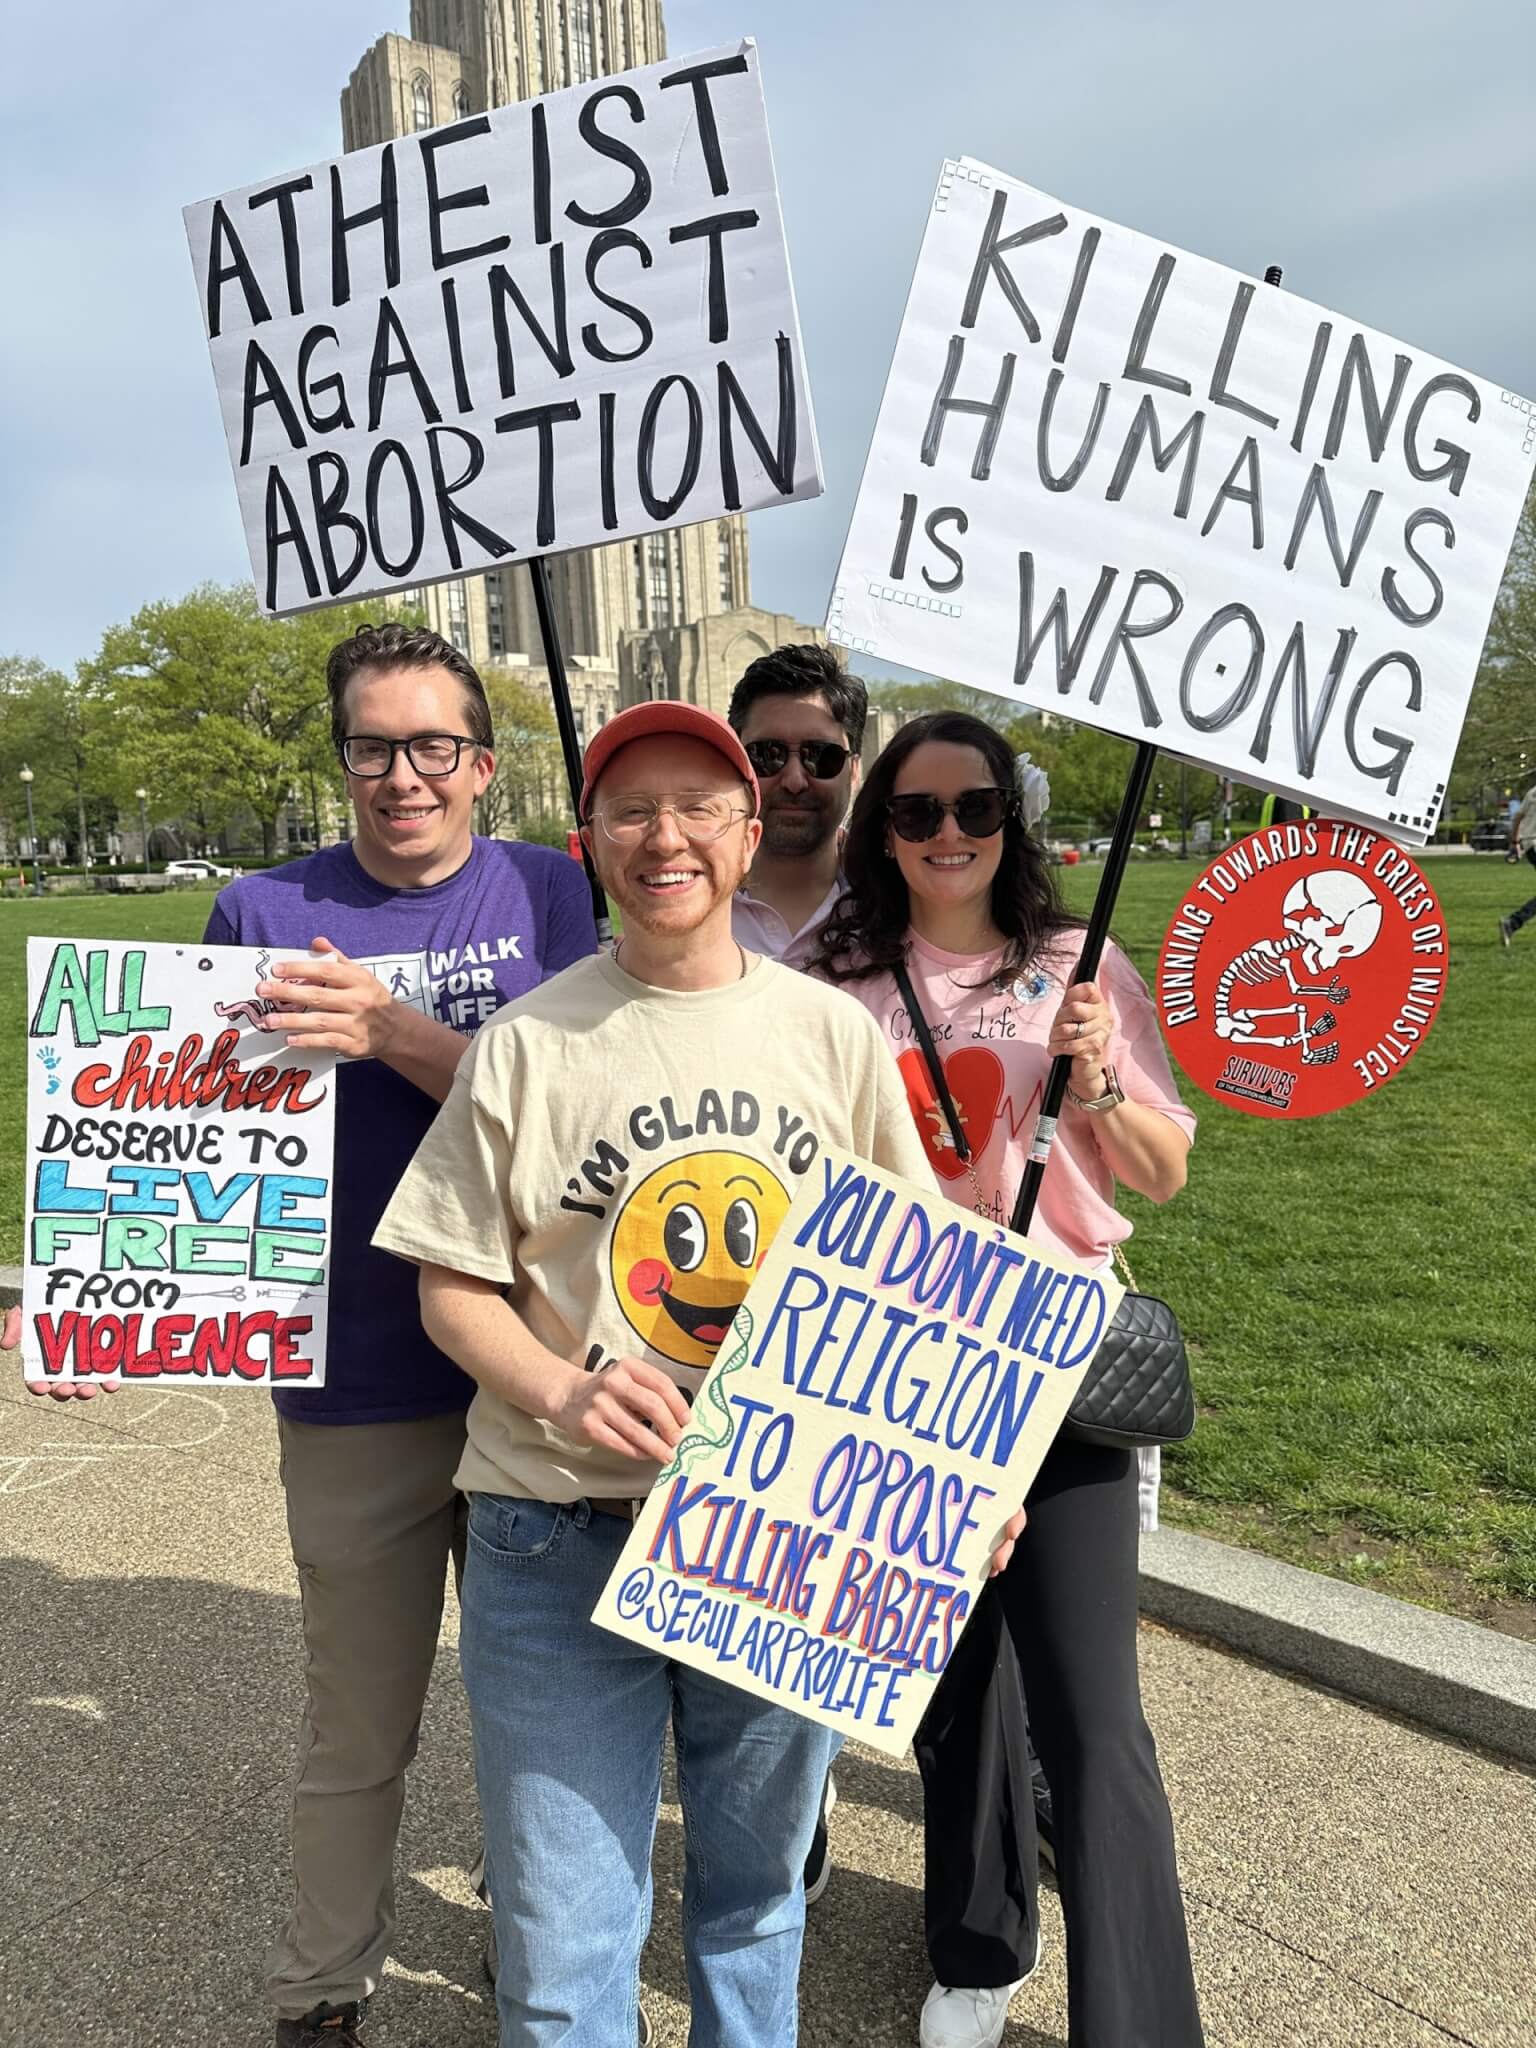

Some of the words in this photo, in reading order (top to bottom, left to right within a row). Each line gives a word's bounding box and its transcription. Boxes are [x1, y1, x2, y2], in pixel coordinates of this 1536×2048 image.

[207, 54, 749, 338] ATHEIST
[240, 209, 760, 466] AGAINST
[960, 190, 1481, 496] KILLING
[266, 331, 797, 611] ABORTION
[920, 334, 1456, 628] HUMANS
[890, 493, 968, 593] IS
[1013, 551, 1422, 796] WRONG
[1197, 822, 1319, 903] TOWARDS
[1329, 823, 1377, 867] THE
[1374, 848, 1434, 920] CRIES
[430, 936, 523, 975] WALK
[430, 968, 496, 1004] FOR
[1162, 903, 1214, 1027] RUNNING
[1411, 923, 1445, 955] OF
[30, 943, 172, 1048] ALL
[435, 996, 497, 1028] LIFE
[971, 1006, 1017, 1039] Life
[1353, 967, 1443, 1088] INJUSTICE
[72, 1029, 328, 1114] children
[1223, 1055, 1297, 1096] SURVIVORS
[36, 1114, 224, 1163] DESERVE
[238, 1128, 309, 1167] TO
[560, 1138, 630, 1220] I'M
[629, 1088, 761, 1151] GLAD
[34, 1160, 328, 1233] LIVE
[31, 1216, 326, 1285] FREE
[46, 1269, 181, 1310] FROM
[793, 1157, 897, 1269] YOU
[875, 1202, 1026, 1330] DON'T
[997, 1258, 1106, 1369] NEED
[34, 1311, 314, 1380] VIOLENCE
[751, 1266, 1045, 1468] RELIGION
[723, 1395, 795, 1492] TO
[810, 1433, 997, 1580] OPPOSE
[646, 1475, 833, 1620] KILLING
[819, 1546, 971, 1674] BABIES
[616, 1566, 913, 1728] @SECULARPROLIFE
